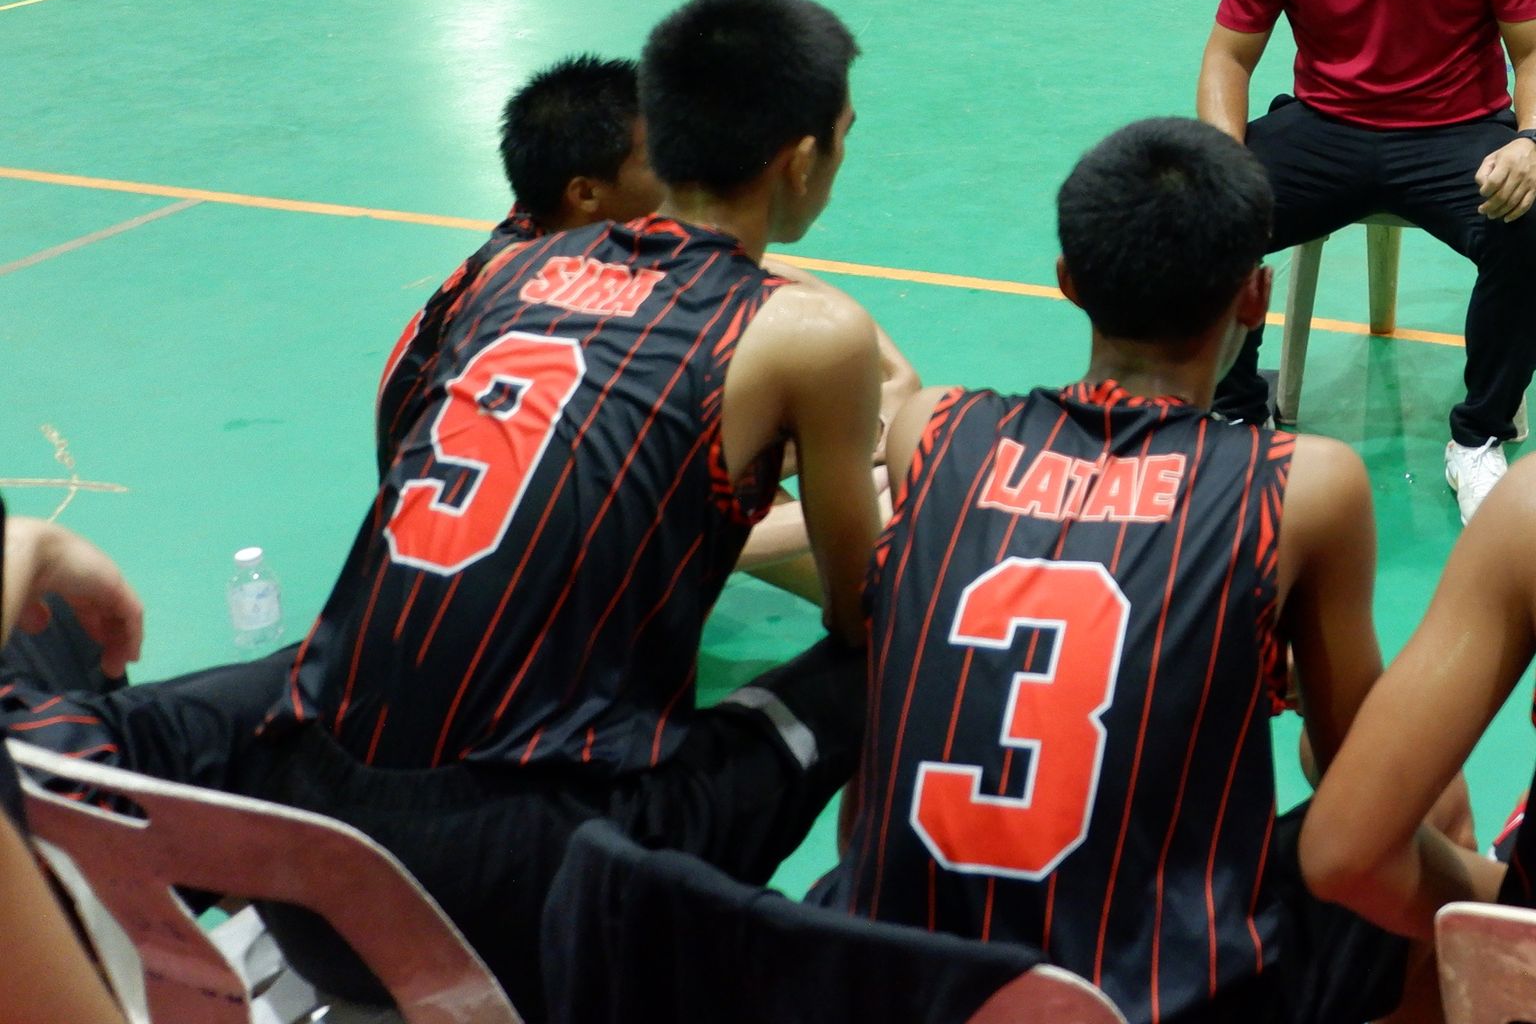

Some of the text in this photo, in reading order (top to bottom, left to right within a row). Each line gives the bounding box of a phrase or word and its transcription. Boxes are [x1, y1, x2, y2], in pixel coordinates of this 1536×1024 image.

[383, 331, 587, 577] 9
[977, 438, 1187, 523] LATAE
[910, 557, 1131, 880] 3
